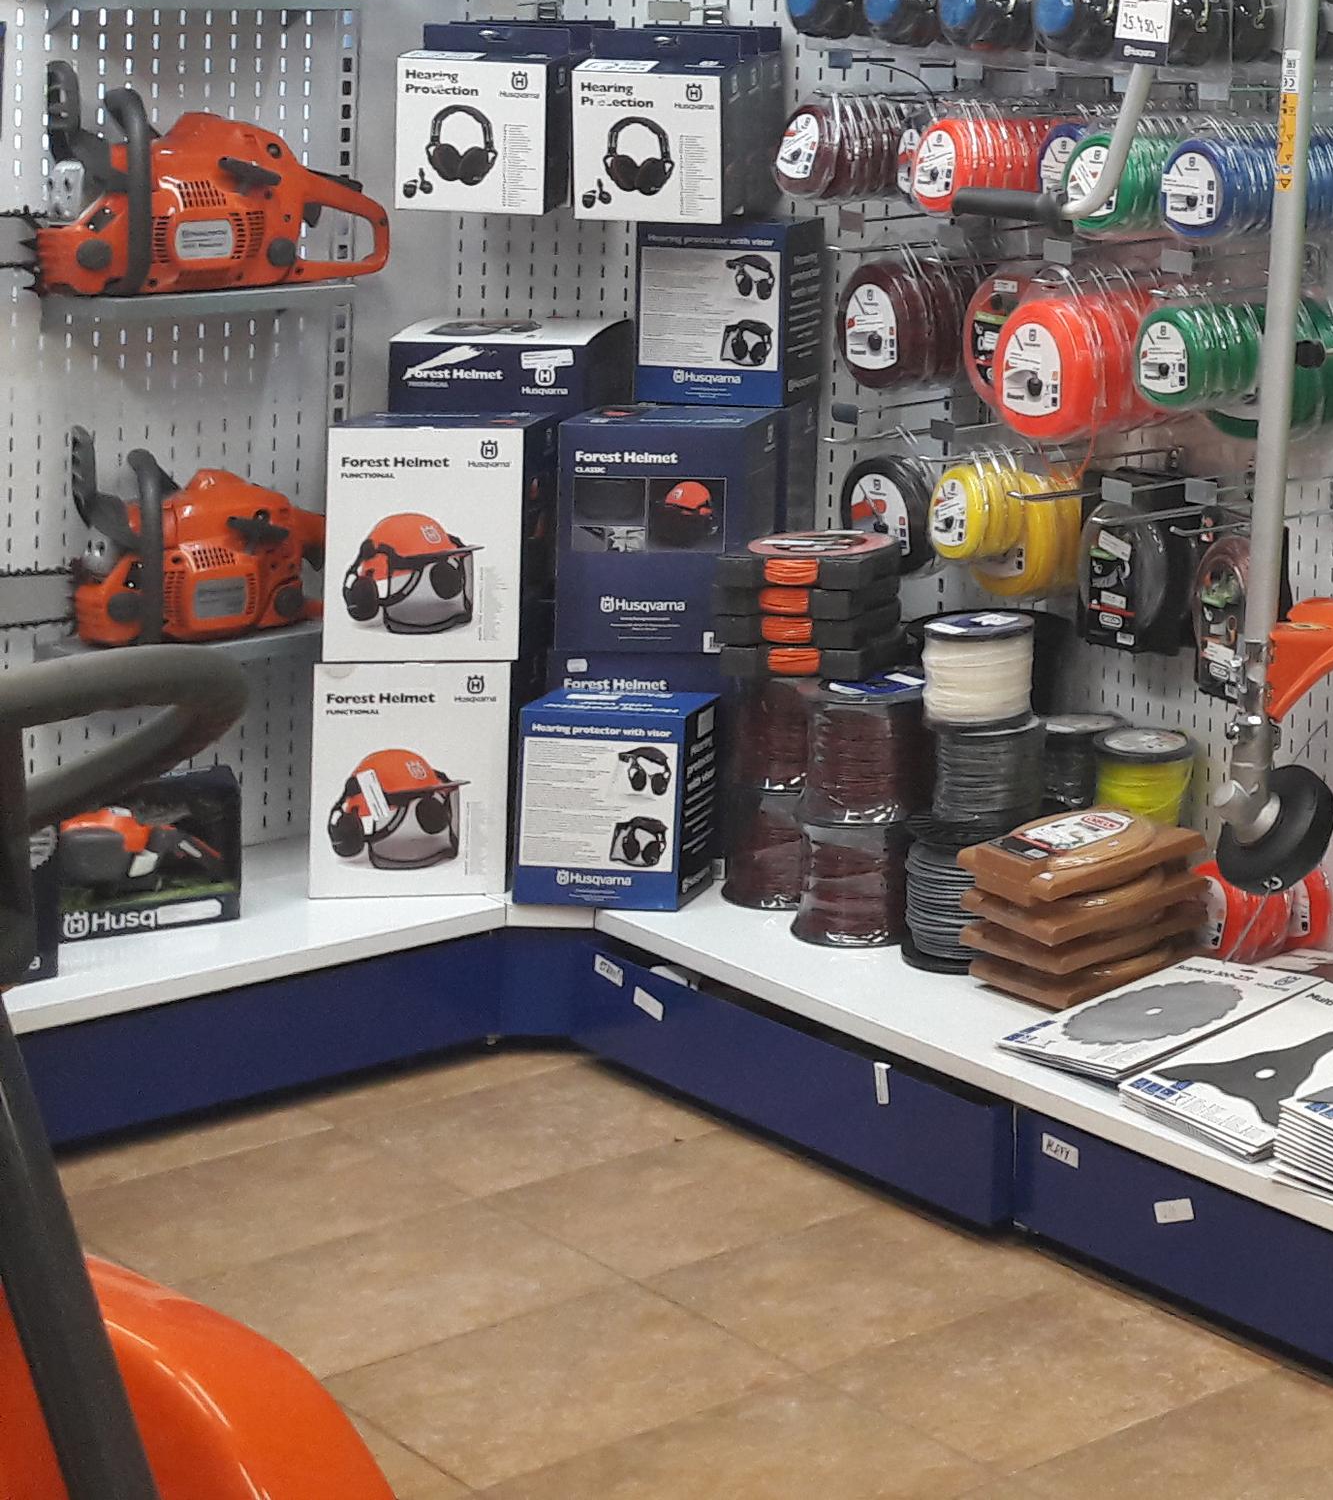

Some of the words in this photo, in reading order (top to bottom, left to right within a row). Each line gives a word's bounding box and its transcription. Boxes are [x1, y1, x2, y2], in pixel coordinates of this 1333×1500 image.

[405, 69, 459, 84] Hearing
[580, 81, 634, 96] Hearing
[452, 367, 503, 381] Helmet
[684, 370, 742, 385] Husqvarna
[341, 455, 391, 469] Forest
[394, 455, 450, 469] Helmet
[575, 450, 622, 465] Forest
[623, 450, 678, 465] Helmet
[615, 598, 686, 614] Husqvarna
[613, 678, 667, 691] Helmet
[326, 691, 376, 706] Forest
[379, 691, 436, 705] Helmet
[532, 723, 571, 735] Hearing
[572, 724, 621, 736] protector
[623, 727, 645, 737] with
[647, 728, 672, 738] visor
[569, 871, 632, 886] Husqvarna
